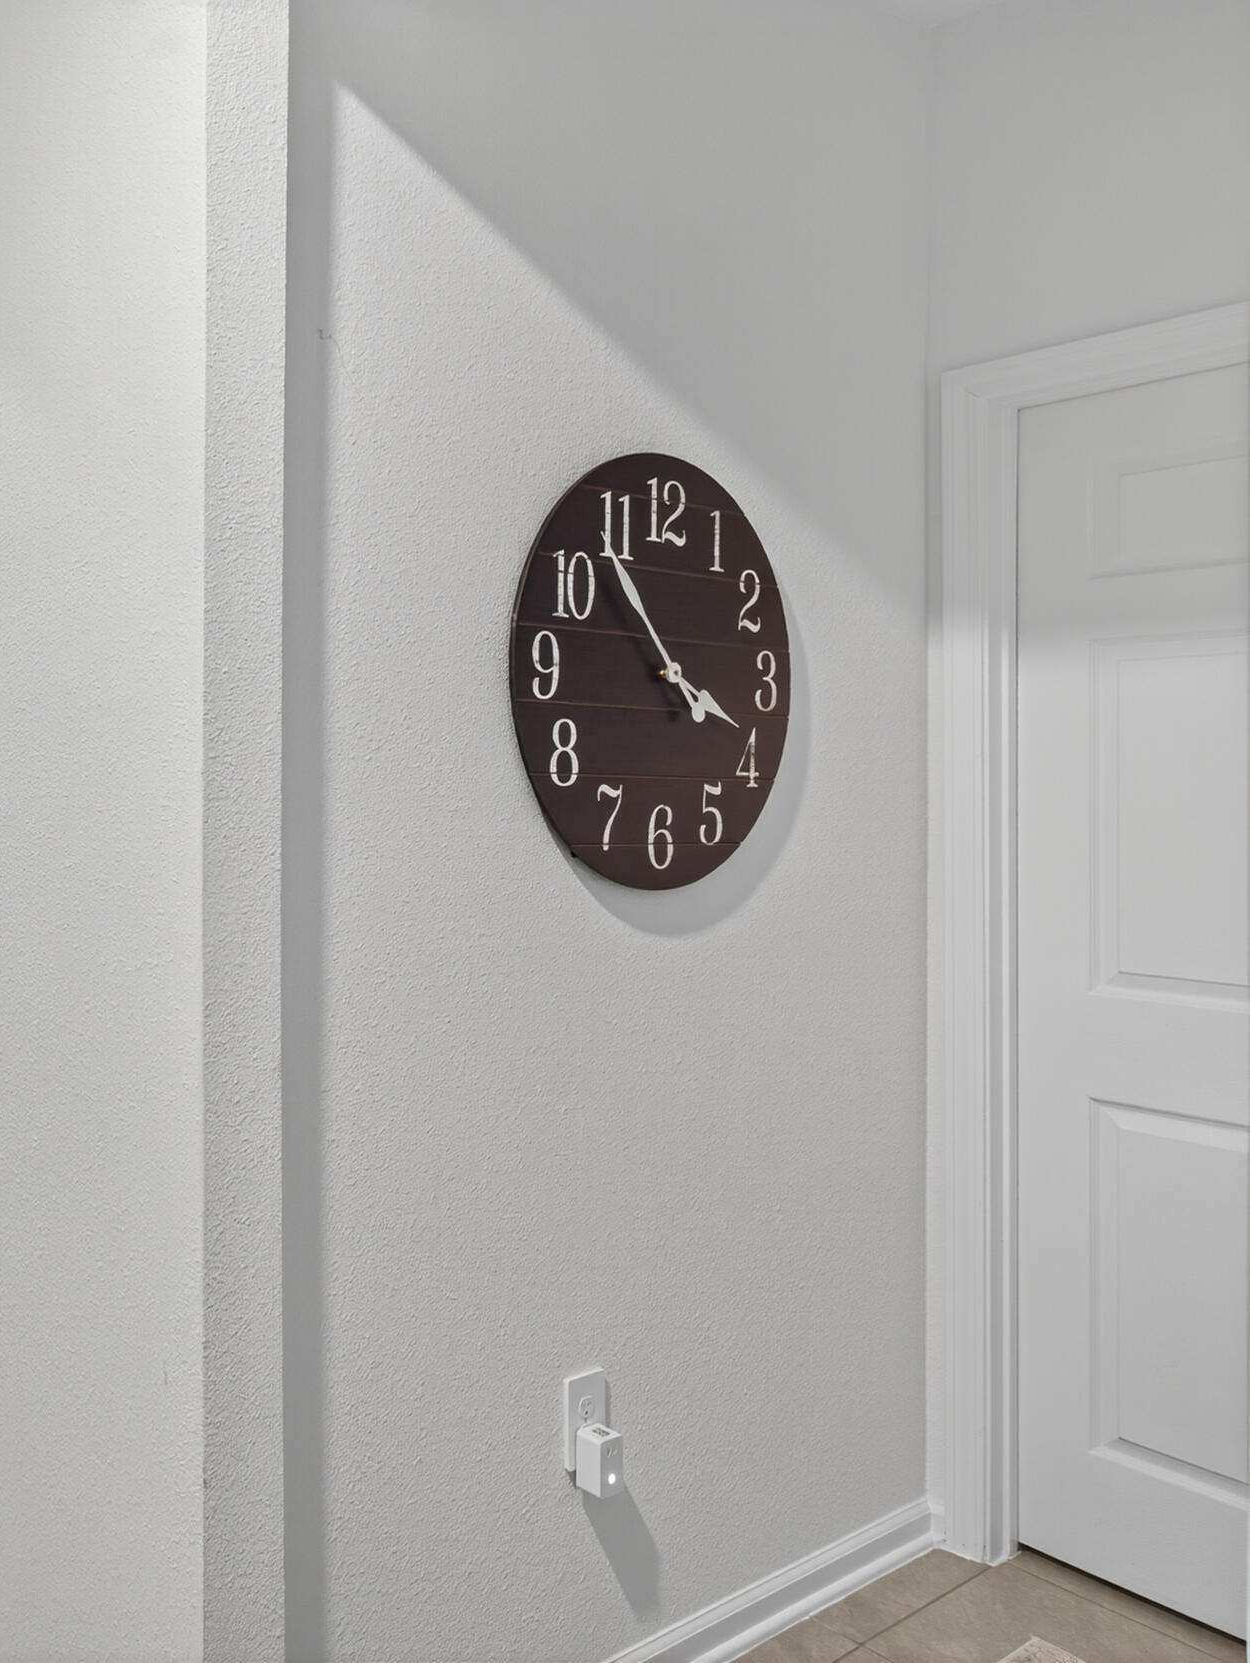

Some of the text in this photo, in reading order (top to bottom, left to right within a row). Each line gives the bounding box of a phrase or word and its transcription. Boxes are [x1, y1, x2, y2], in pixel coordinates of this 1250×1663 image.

[599, 490, 634, 561] 11
[646, 477, 687, 547] 12
[709, 510, 725, 573] 1
[551, 549, 596, 620] 10
[737, 569, 761, 634] 2
[531, 630, 560, 700] 9
[754, 650, 778, 712] 3
[549, 718, 579, 787] 8
[735, 727, 760, 788] 4
[597, 783, 623, 852] 7
[647, 804, 675, 870] 6
[699, 780, 723, 846] 5
